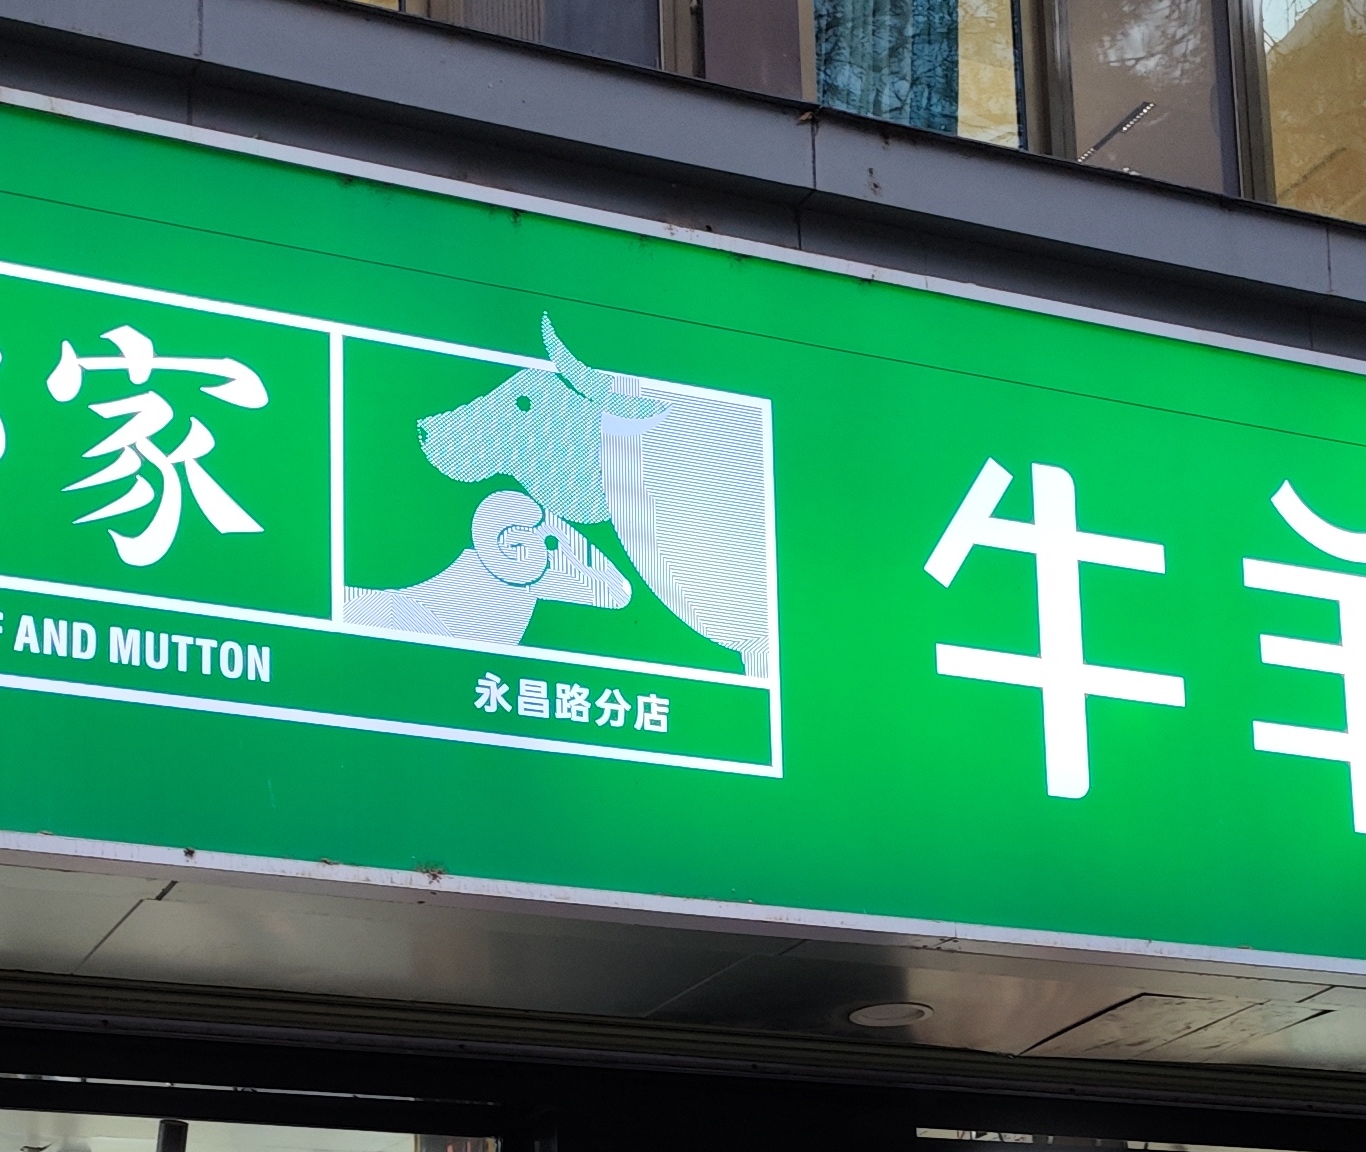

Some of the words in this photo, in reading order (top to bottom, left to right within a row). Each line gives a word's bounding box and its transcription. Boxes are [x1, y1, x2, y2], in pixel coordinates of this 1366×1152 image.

[13, 614, 97, 660] AND
[109, 626, 270, 683] MUTTON
[474, 672, 670, 733] 永昌路分店
